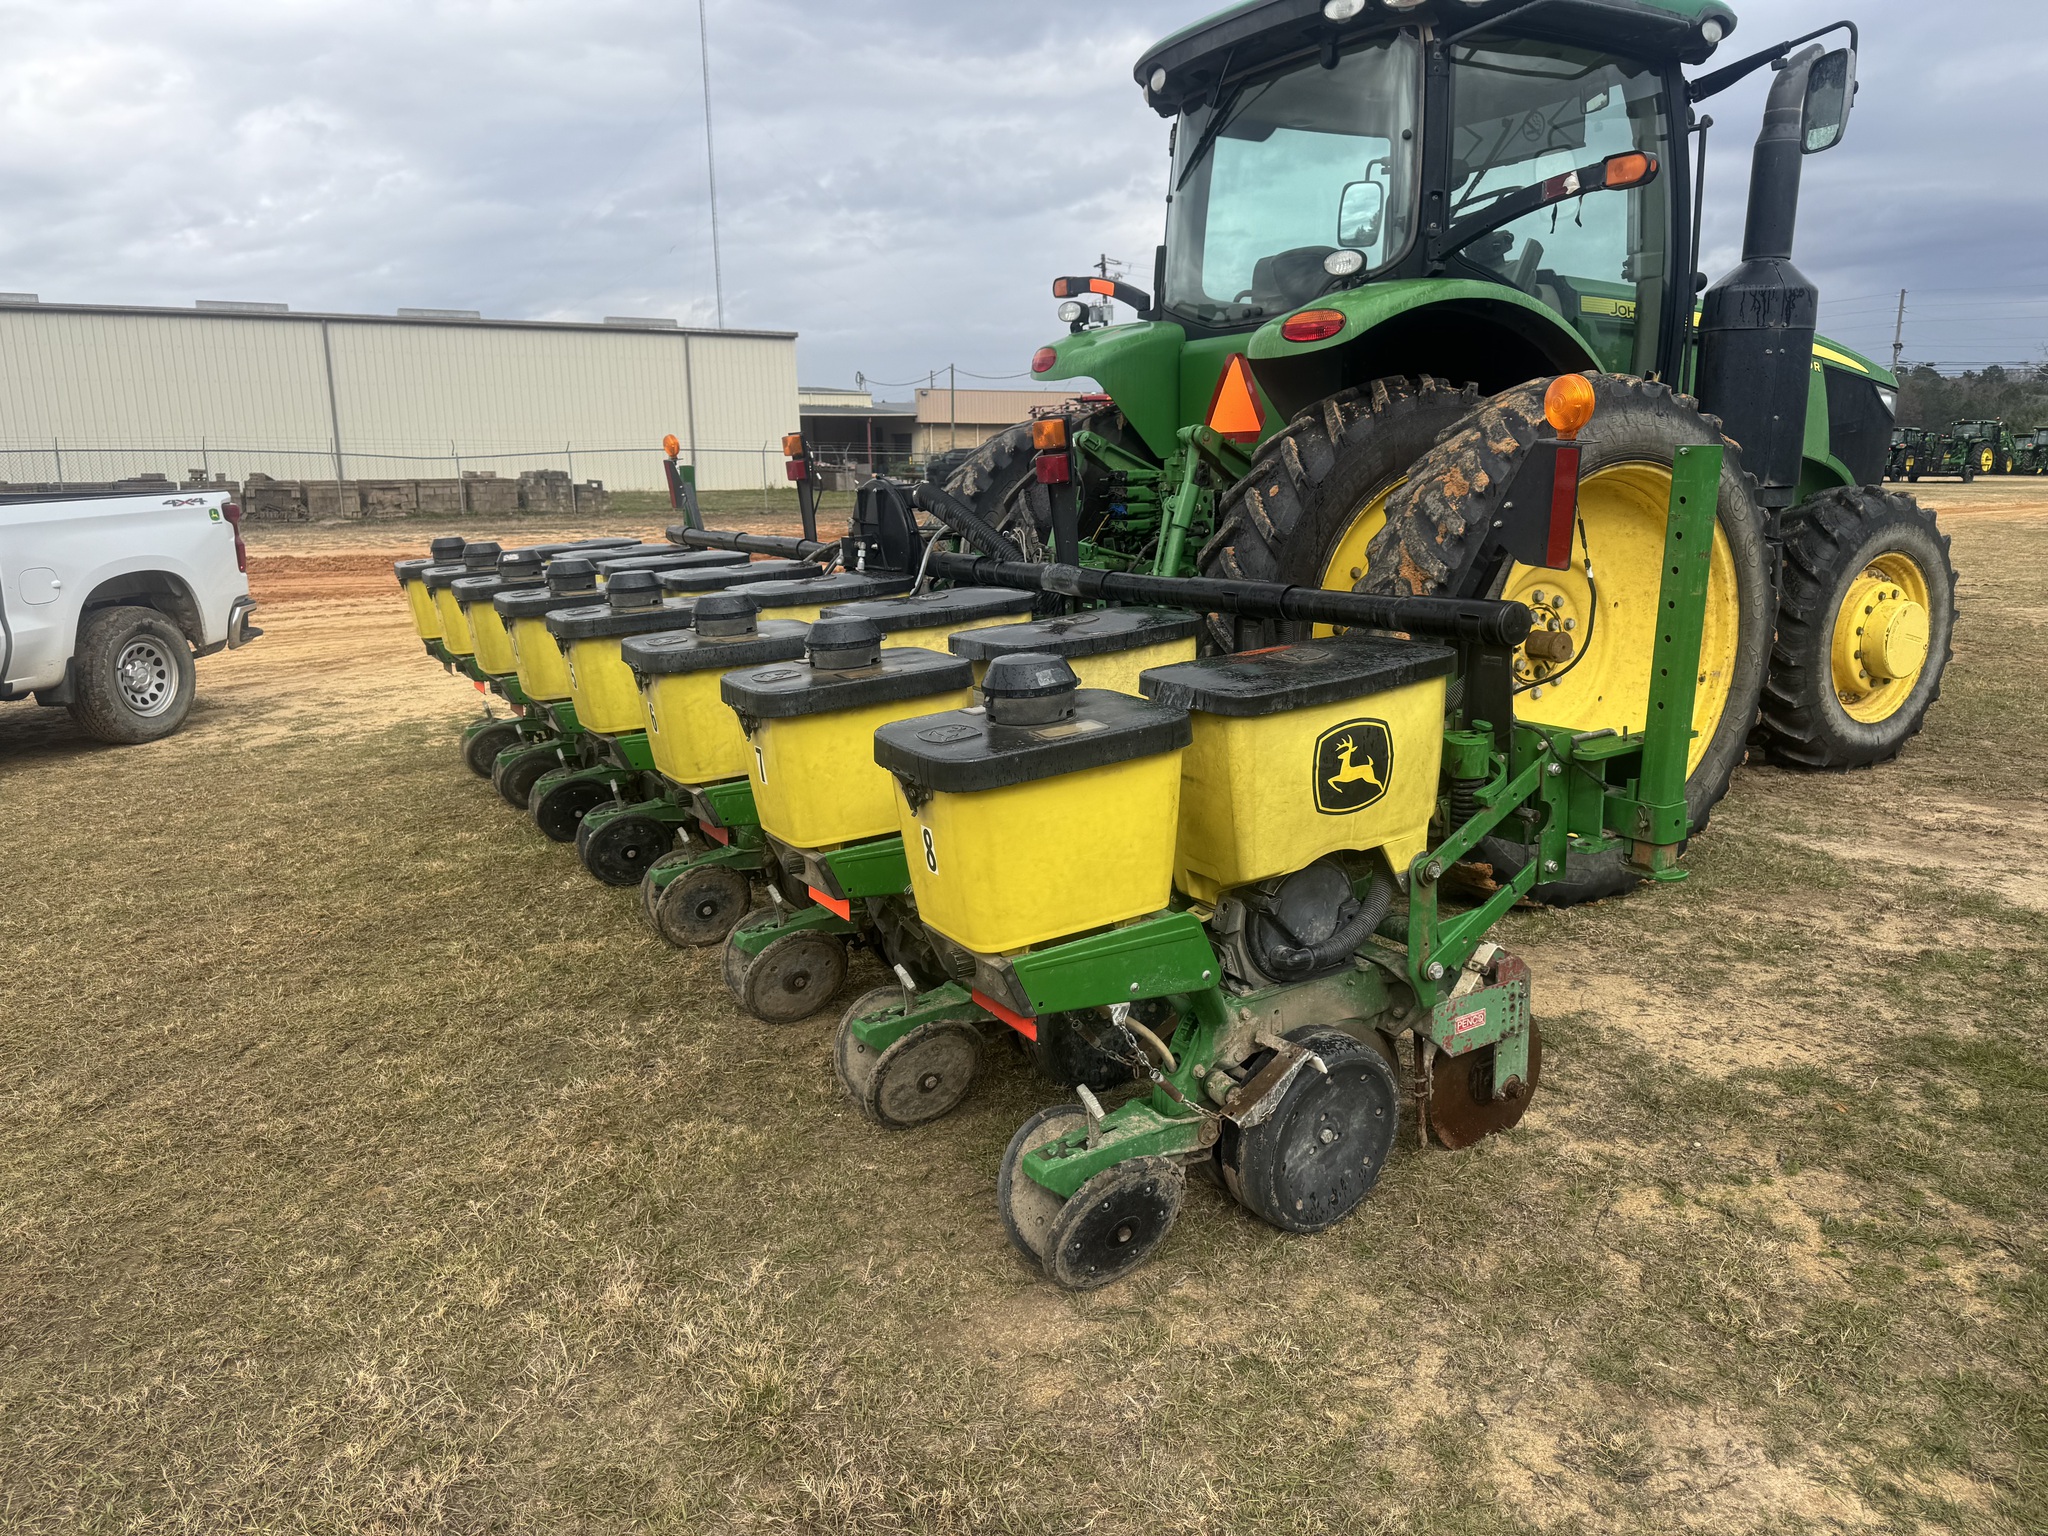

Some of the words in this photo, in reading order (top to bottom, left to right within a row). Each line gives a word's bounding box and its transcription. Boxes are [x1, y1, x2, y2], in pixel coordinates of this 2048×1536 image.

[1610, 302, 1636, 317] JOH
[649, 703, 659, 732] 6
[755, 747, 767, 783] 7
[923, 828, 937, 873] 8
